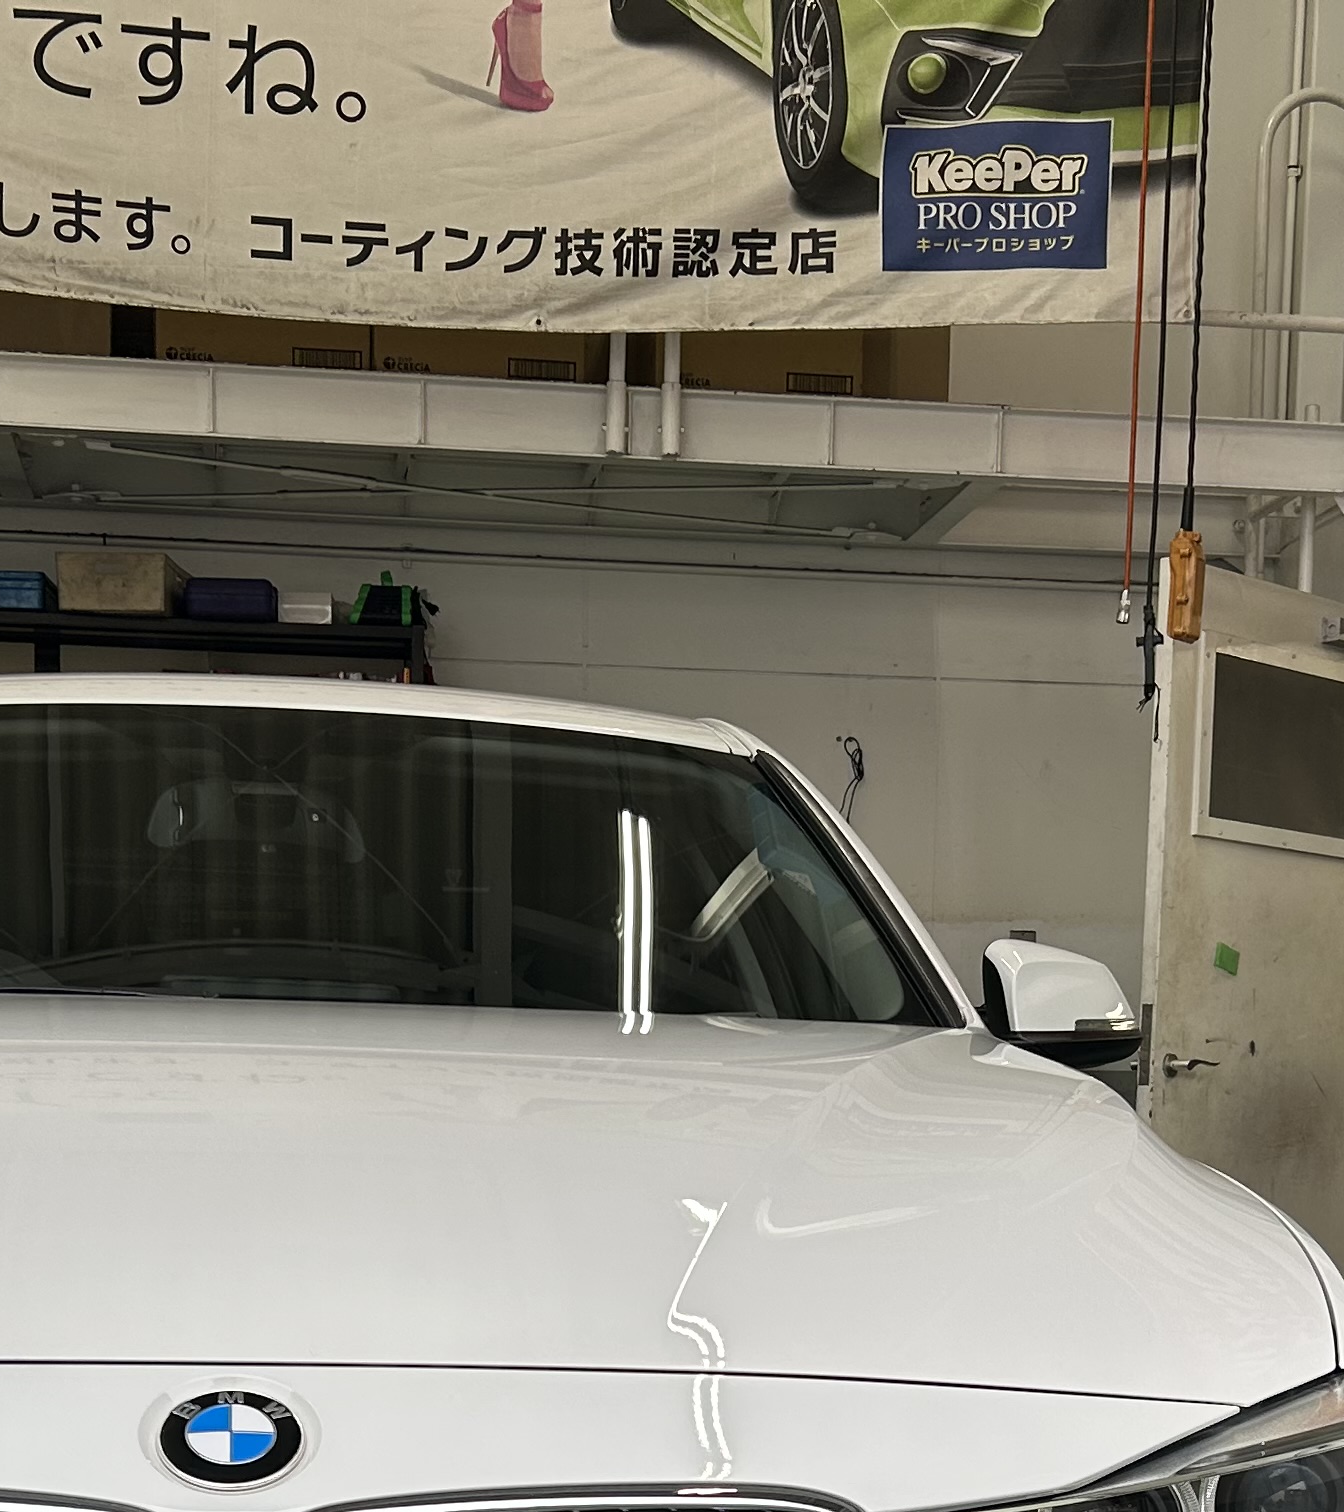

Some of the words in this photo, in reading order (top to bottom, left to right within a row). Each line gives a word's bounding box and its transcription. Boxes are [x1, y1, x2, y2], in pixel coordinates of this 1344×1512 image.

[911, 147, 1086, 196] KeePer
[917, 202, 982, 230] PRO
[989, 202, 1077, 230] SHOP
[250, 214, 838, 277] コーティング技術認定店
[916, 235, 1075, 253] キーパープロショップ
[179, 352, 214, 362] CRECIA
[397, 362, 431, 372] CRECIA
[172, 1391, 292, 1420] BMW
